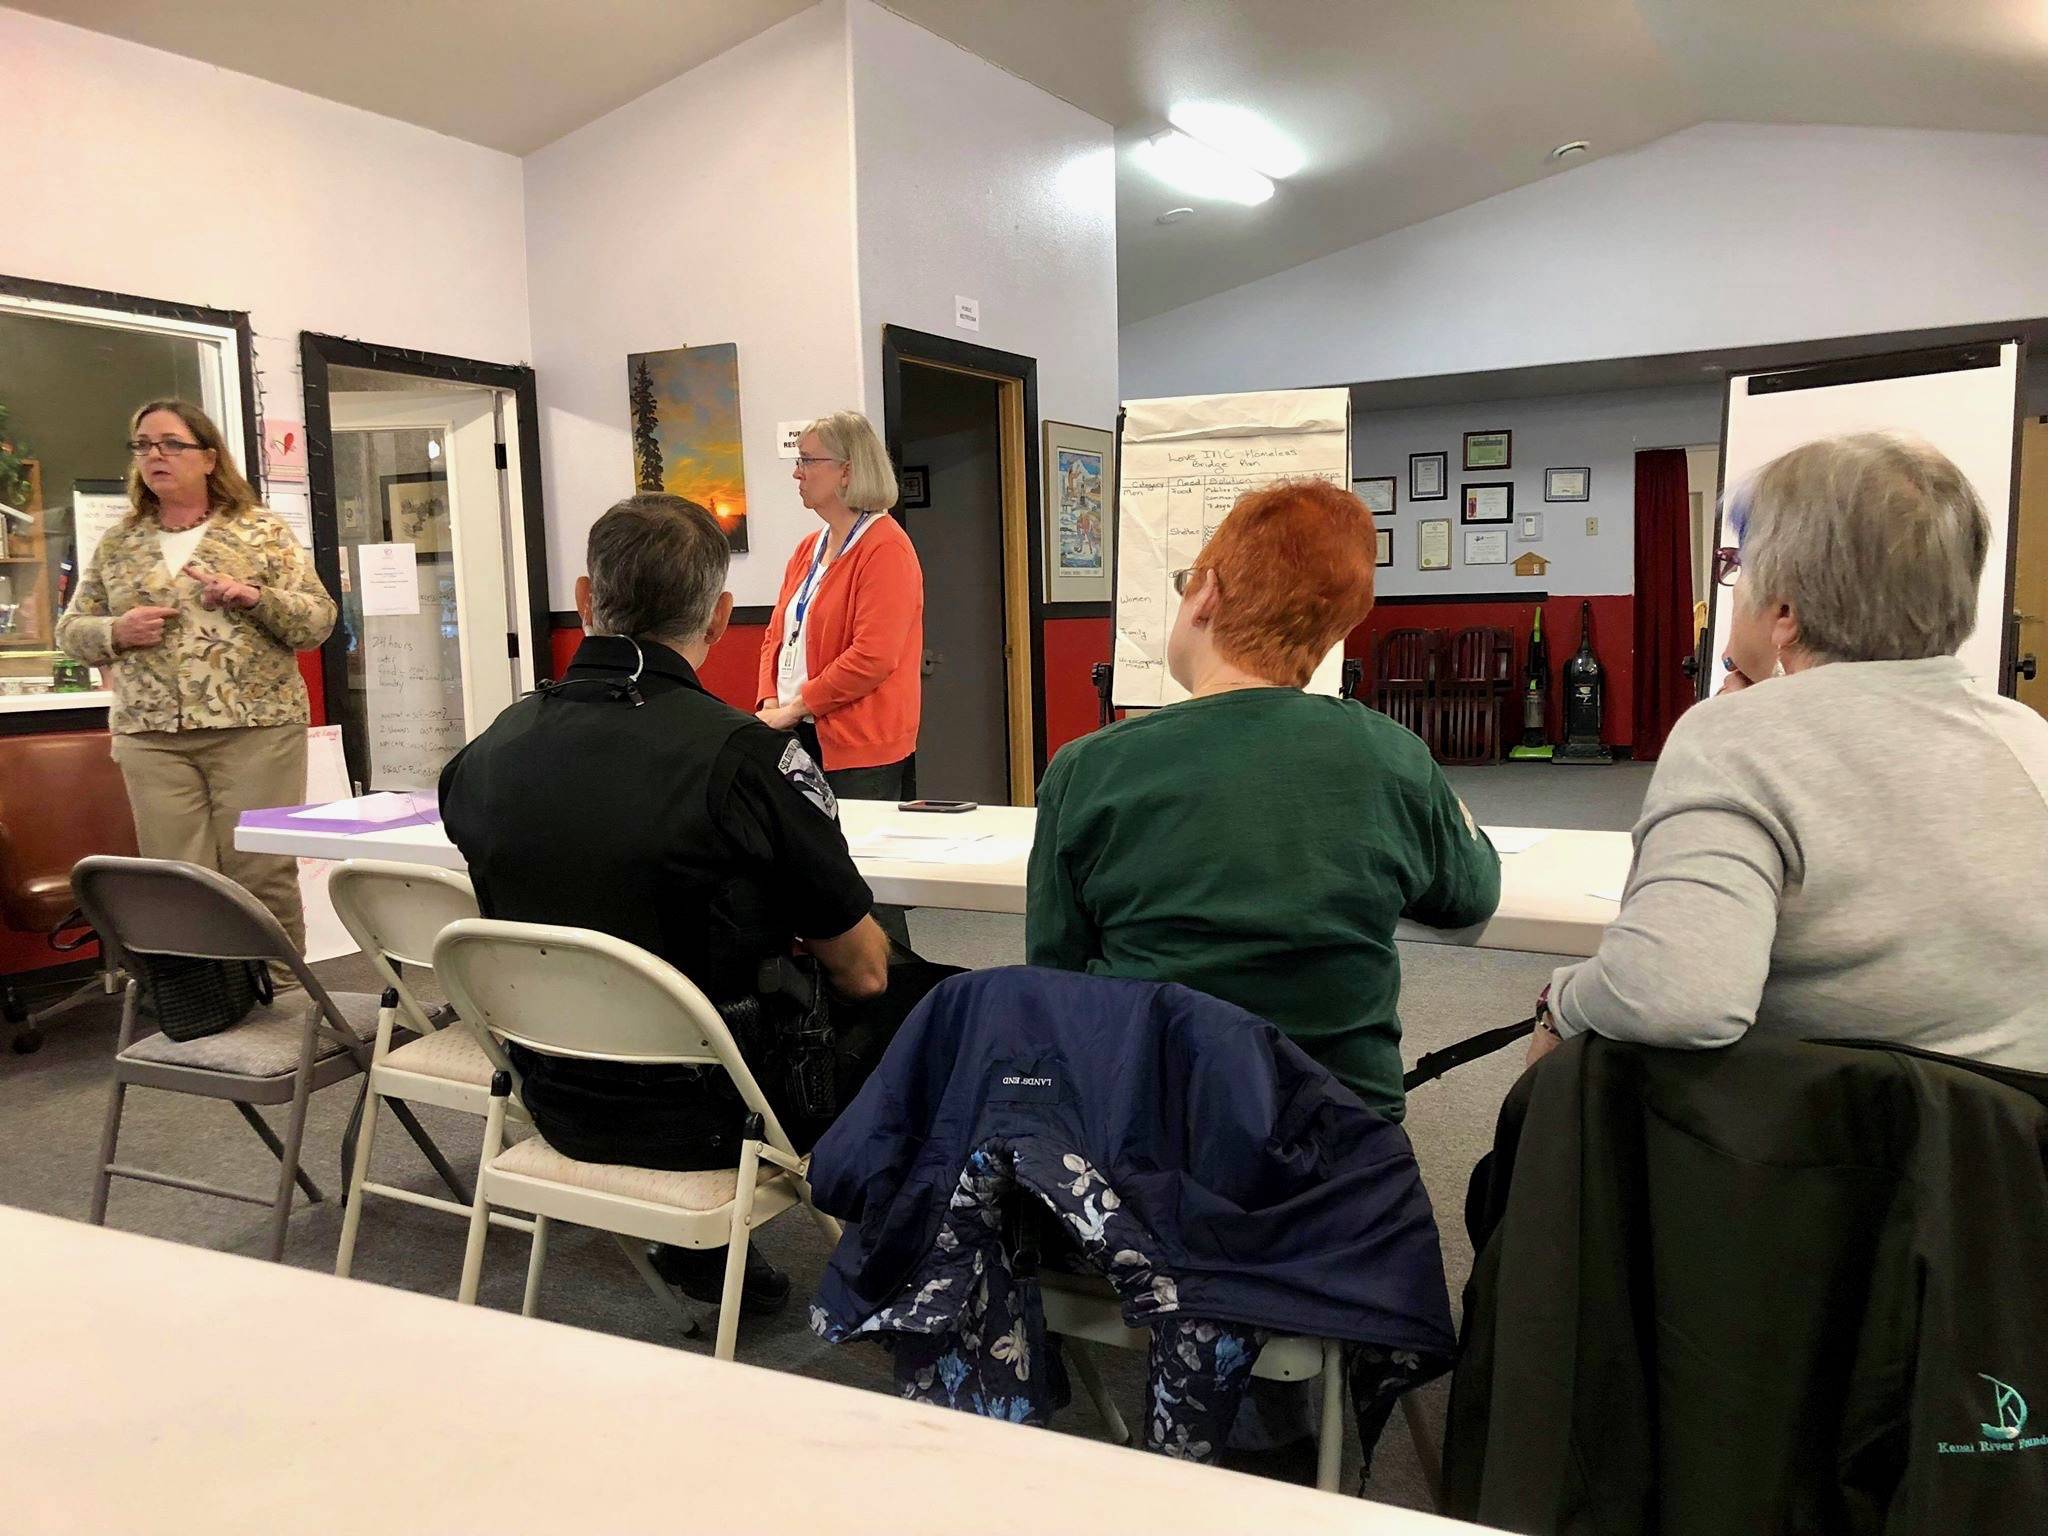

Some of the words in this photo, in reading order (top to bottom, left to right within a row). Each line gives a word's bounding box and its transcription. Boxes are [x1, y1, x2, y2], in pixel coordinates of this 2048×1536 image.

[1169, 453, 1197, 462] Love
[1192, 460, 1228, 474] Bridge
[1120, 595, 1152, 604] Women
[1938, 1442, 1974, 1453] Kenai
[1979, 1440, 2014, 1452] River
